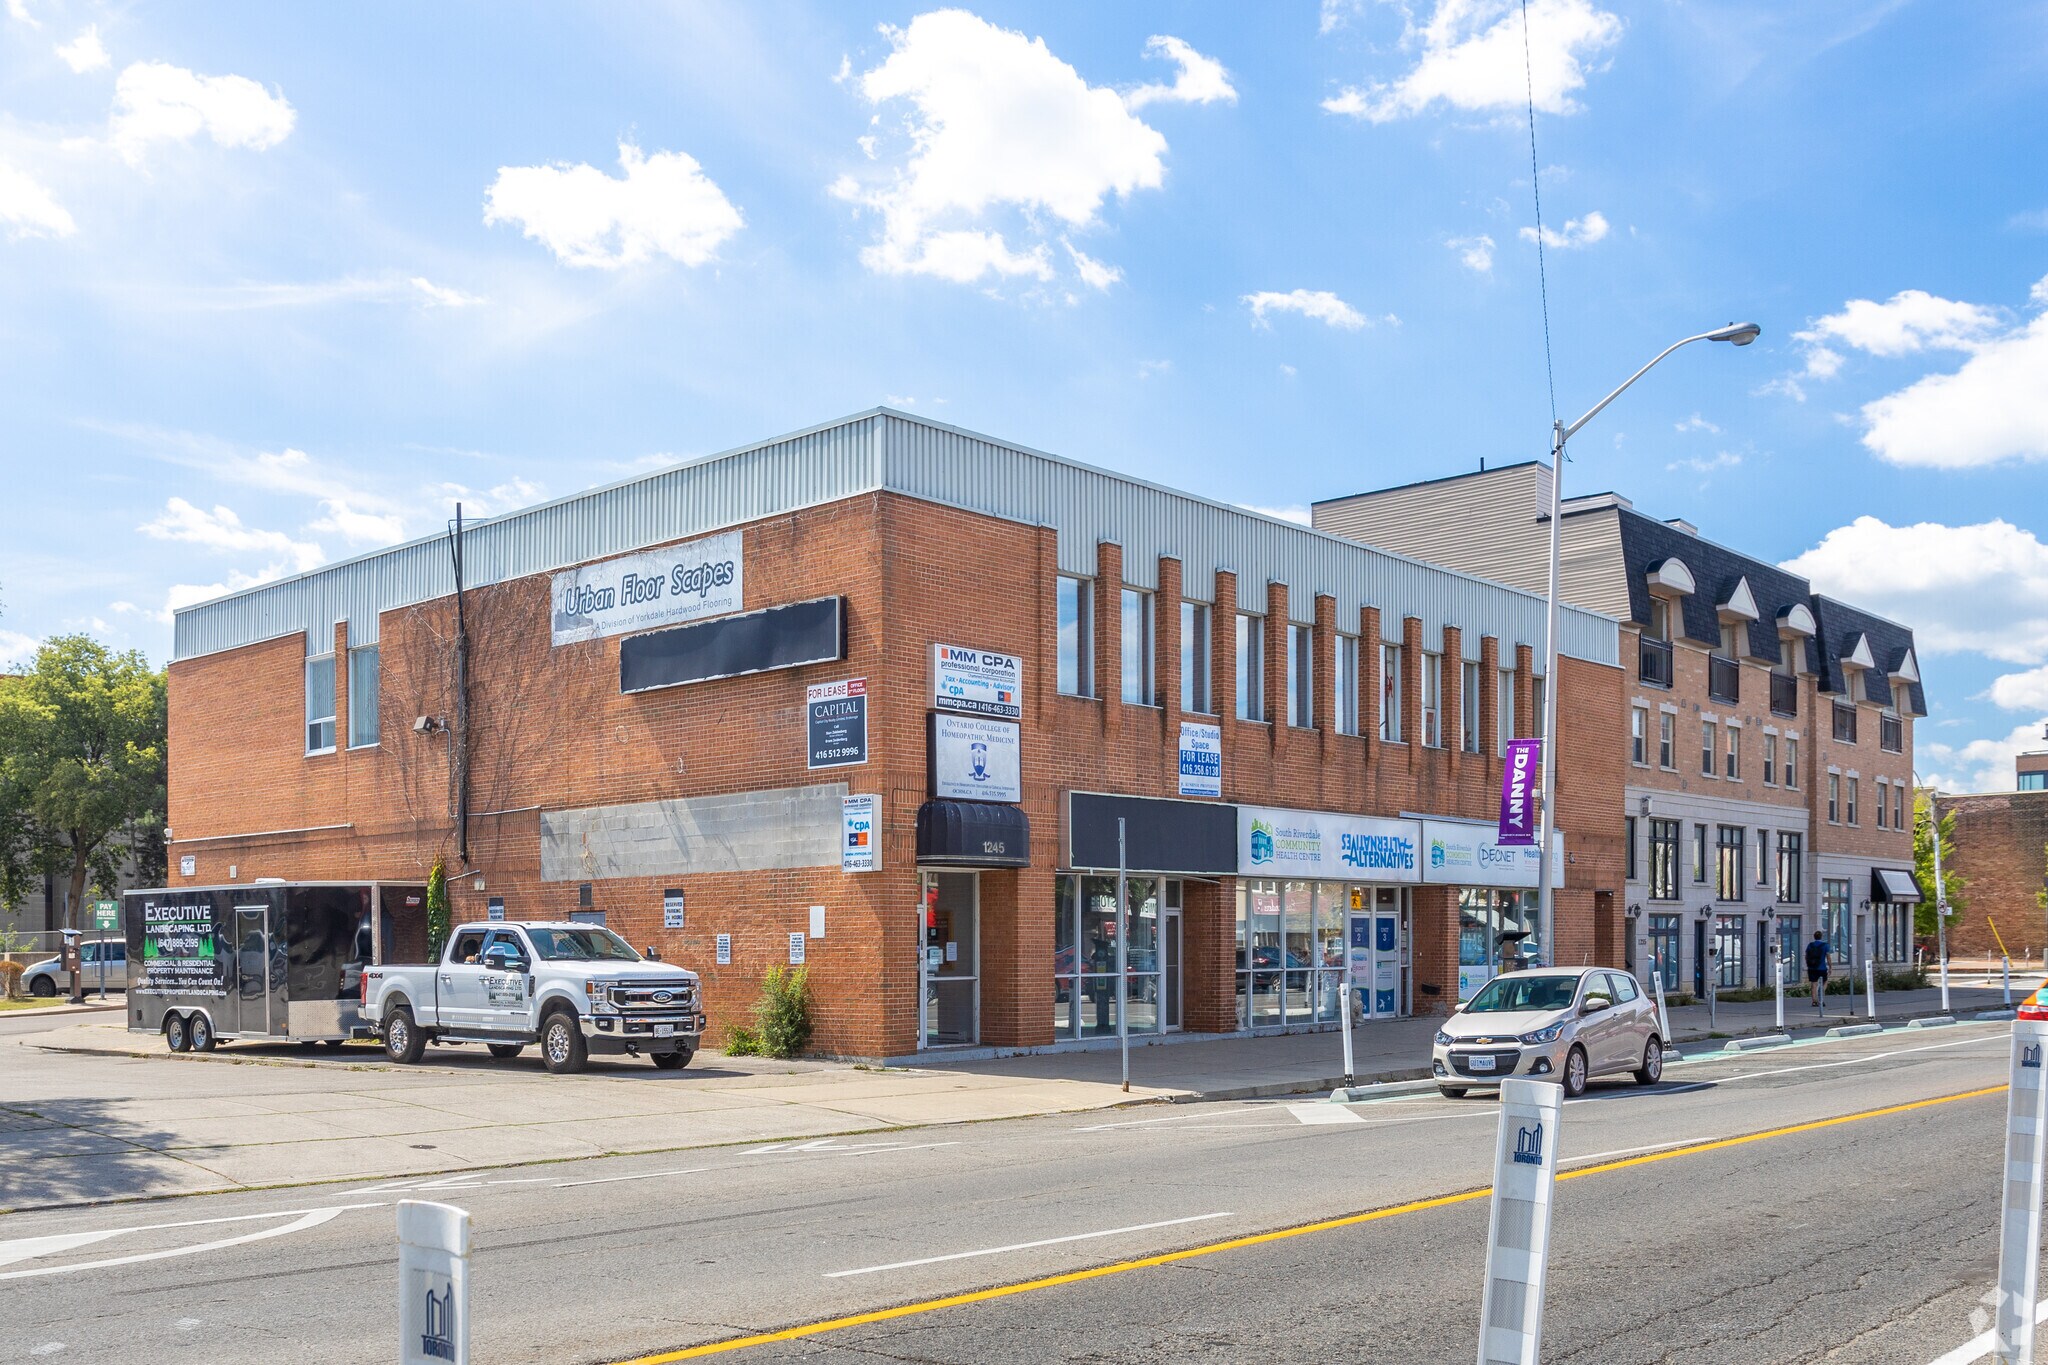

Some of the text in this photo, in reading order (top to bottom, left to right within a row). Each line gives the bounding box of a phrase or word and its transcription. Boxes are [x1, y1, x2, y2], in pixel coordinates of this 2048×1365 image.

[566, 561, 733, 616] Urban Floor Scapes
[602, 617, 626, 629] Division
[627, 615, 635, 624] of
[636, 610, 664, 622] Yorkdale
[666, 604, 701, 616] Hardwood
[703, 597, 732, 609] Flooring
[950, 650, 1014, 669] MM CPA
[941, 661, 1015, 678] professional corporation
[809, 685, 846, 699] FOR LEASE
[959, 678, 989, 689] Accounting
[993, 682, 1016, 693] Advisory
[815, 701, 858, 718] CAPITAL
[938, 698, 1019, 716] mmcpa.ca 416-463-3330
[946, 718, 974, 730] ONTARIO
[975, 722, 1001, 733] COLLEGE
[942, 729, 1015, 744] HOMEOPATHIC MEDICINE
[1192, 739, 1209, 750] Space
[816, 747, 859, 759] 416 512 9996
[1182, 751, 1218, 764] FOR LEASE
[1508, 754, 1528, 828] DANNY
[1275, 827, 1321, 840] South Riverdale
[983, 841, 1005, 853] 1245
[1276, 841, 1321, 851] COMMUNITY
[1276, 851, 1321, 861] HEALTH CENTRE
[1342, 846, 1413, 869] ALTERNATIVES
[1481, 849, 1516, 863] DECNET
[844, 860, 872, 868] 416-463-3330
[145, 902, 211, 921] EXECUTIVE
[146, 924, 194, 933] LANDSCAPING
[138, 977, 154, 986] Quality
[213, 976, 223, 985] On!
[490, 977, 522, 985] EXECUTIVE
[1514, 1152, 1542, 1165] TORONTO
[421, 1335, 454, 1363] TORONTO
